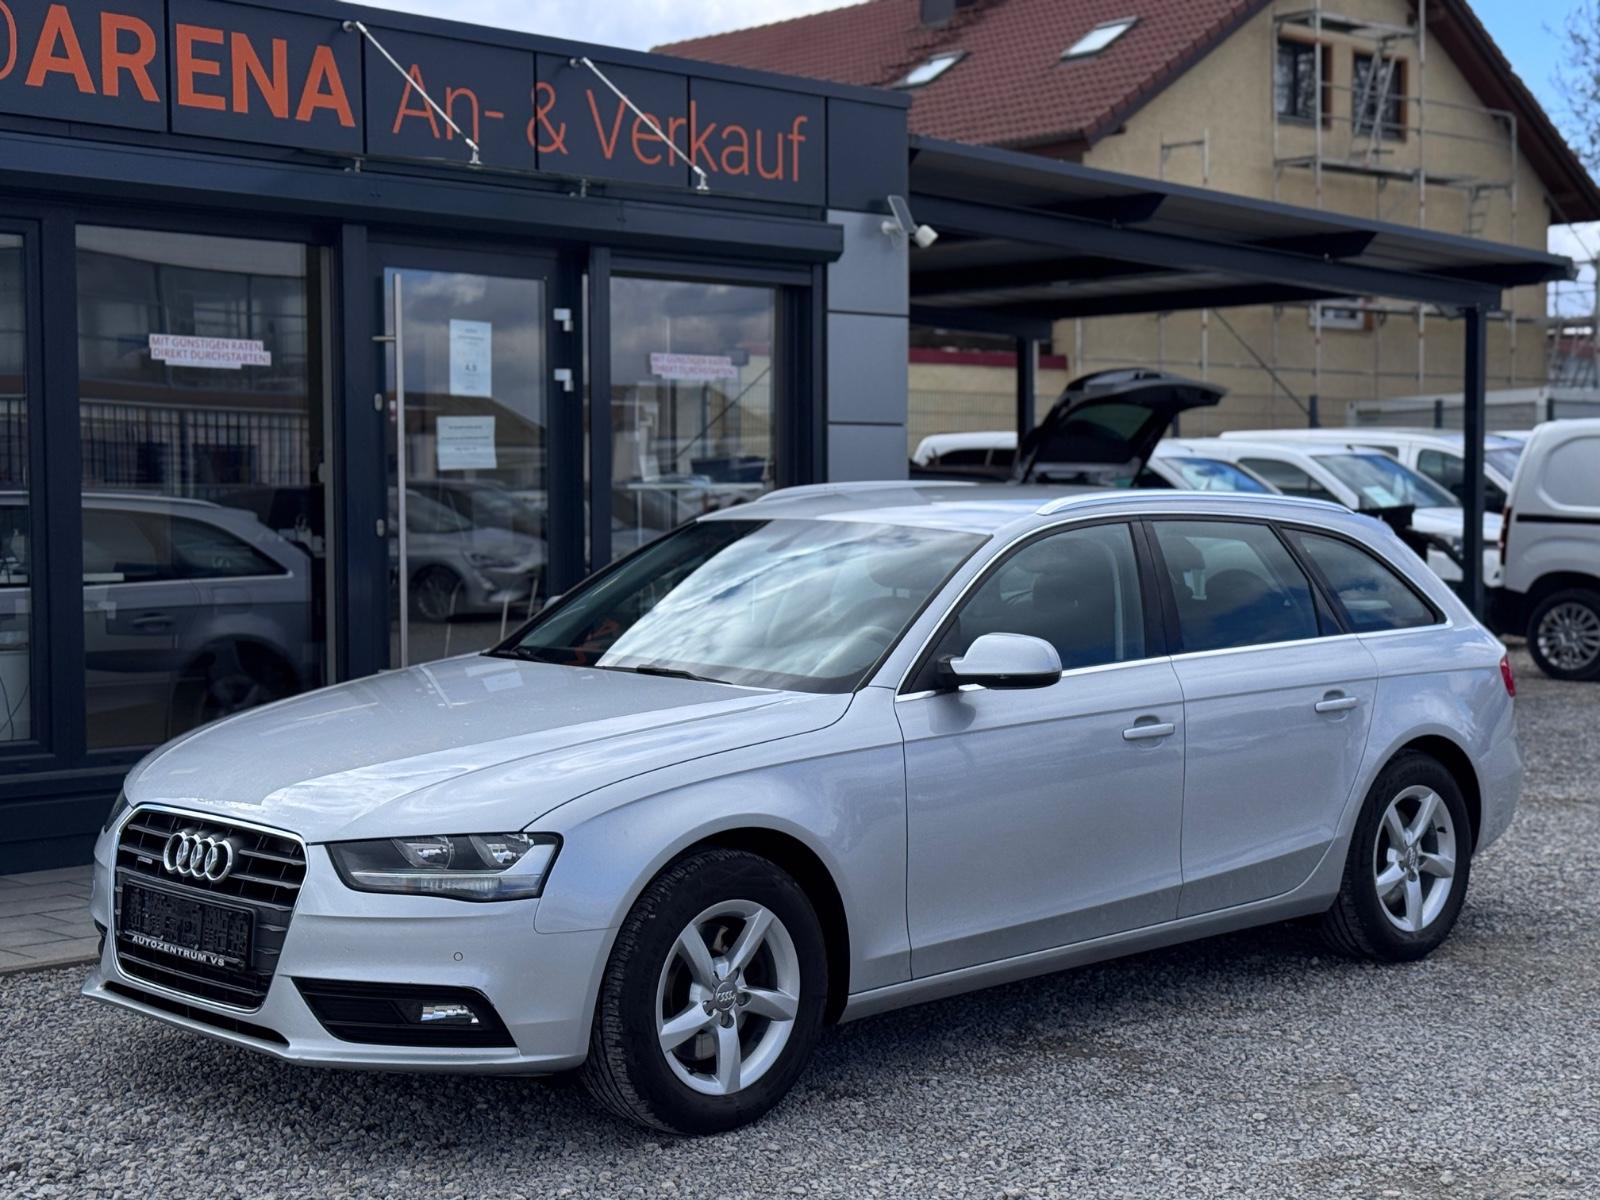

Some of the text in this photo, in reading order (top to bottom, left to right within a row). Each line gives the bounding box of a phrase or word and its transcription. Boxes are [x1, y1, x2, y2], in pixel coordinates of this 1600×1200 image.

[392, 63, 504, 145] An-
[527, 81, 568, 155] &
[586, 89, 808, 182] Verkauf
[151, 336, 169, 346] MIT
[232, 340, 262, 352] RATEN
[153, 347, 188, 359] DIREKT
[132, 935, 225, 967] AUTOZENTRUM VS
